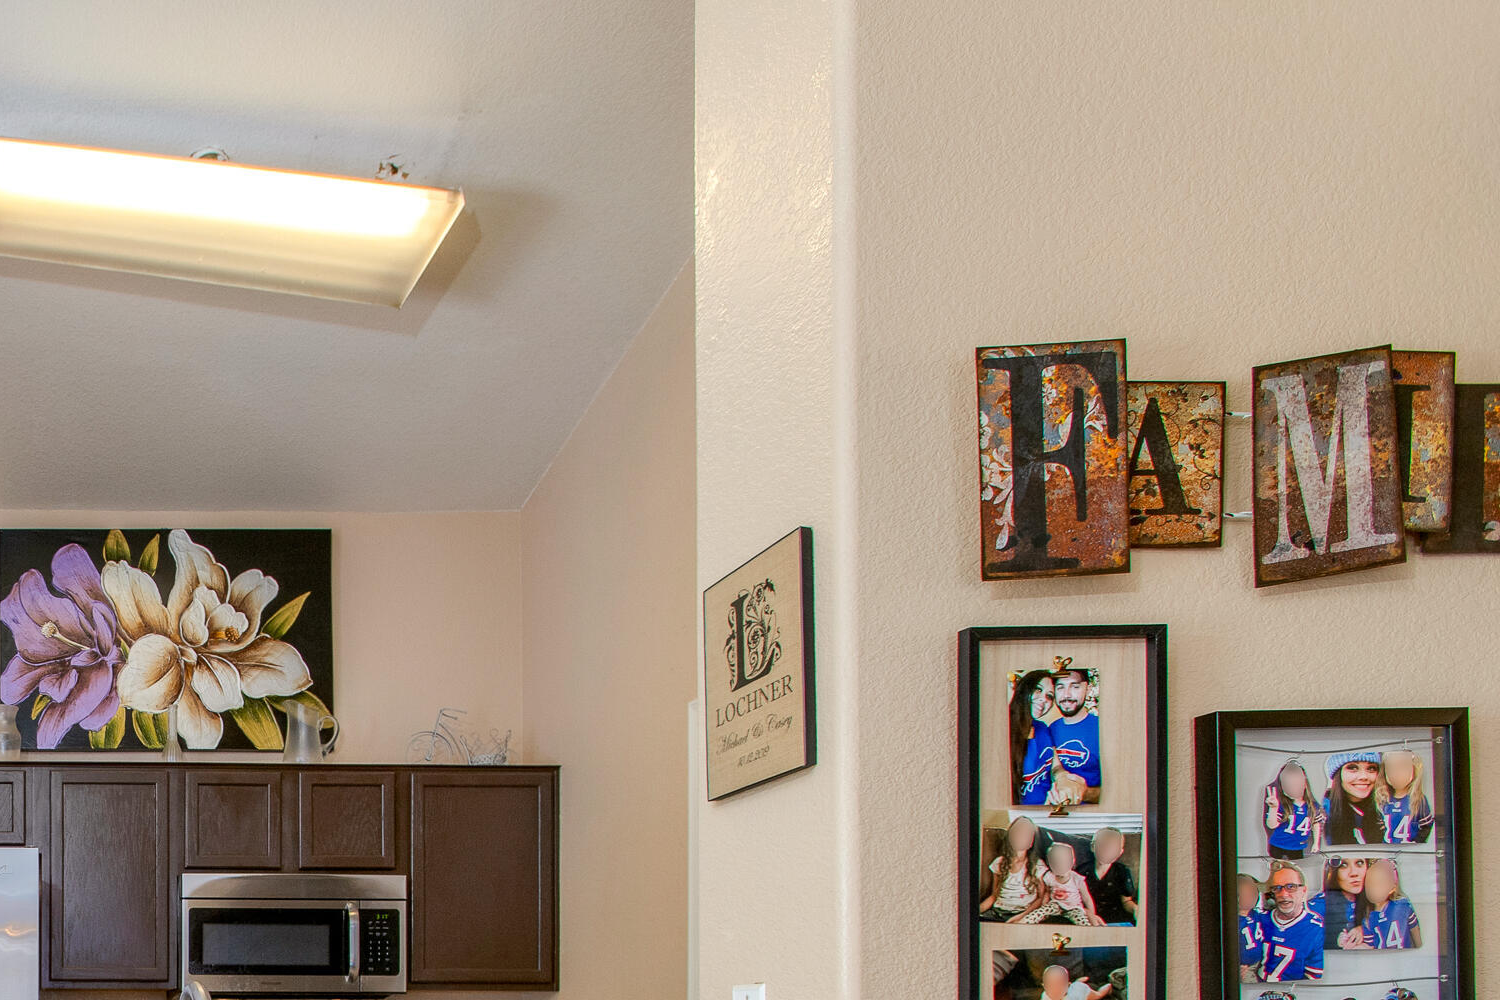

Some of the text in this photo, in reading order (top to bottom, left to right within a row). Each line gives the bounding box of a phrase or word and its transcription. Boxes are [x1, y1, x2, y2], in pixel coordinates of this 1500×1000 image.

[715, 674, 794, 728] LOCHNER
[1283, 814, 1312, 836] 14
[1383, 814, 1416, 843] 14
[1241, 921, 1265, 950] 14
[1258, 942, 1297, 983] 17
